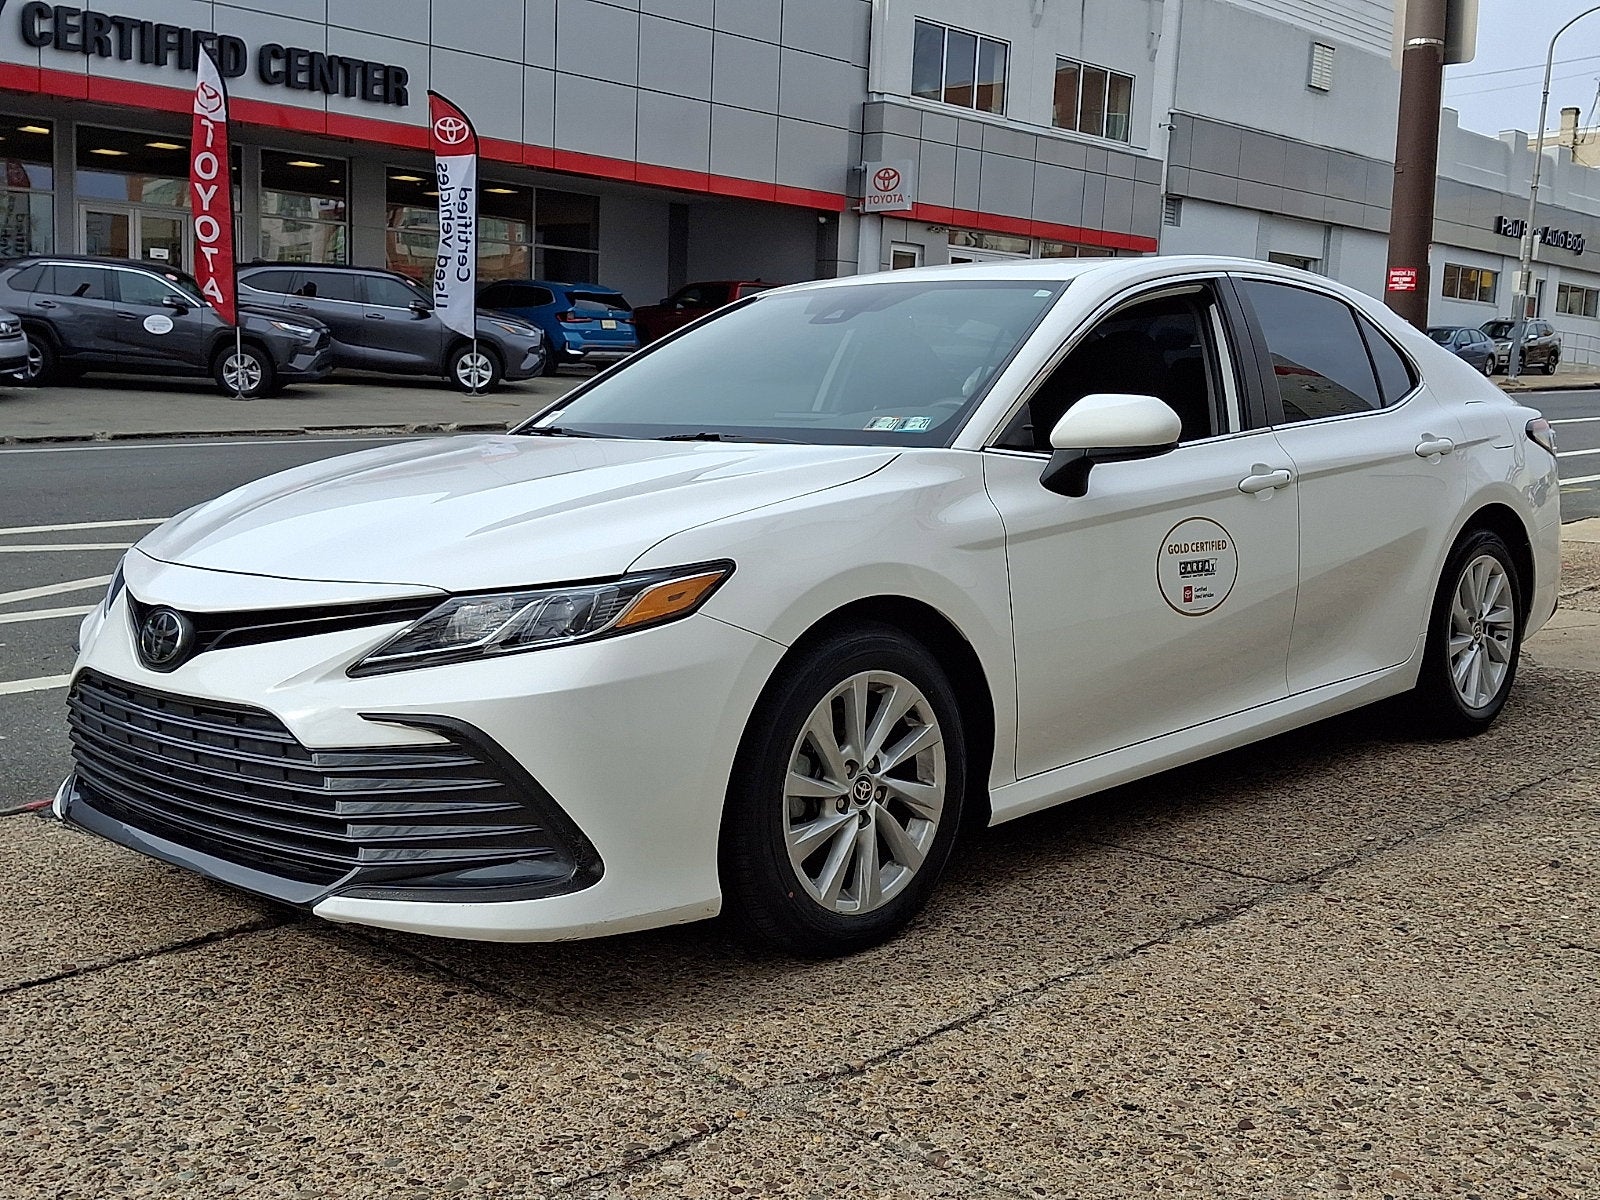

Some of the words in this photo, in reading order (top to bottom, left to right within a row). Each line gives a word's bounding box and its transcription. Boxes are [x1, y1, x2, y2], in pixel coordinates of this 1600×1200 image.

[21, 1, 248, 78] CERTIFIED
[259, 43, 409, 106] CENTER
[194, 118, 223, 304] TOYOTA
[868, 194, 904, 205] TOYOTA
[1498, 215, 1521, 238] Paul
[1544, 228, 1566, 248] Auto
[1566, 230, 1586, 256] Body
[1168, 543, 1189, 555] GOLD
[1190, 539, 1227, 553] CERTIFIED
[1179, 559, 1217, 575] CARFAX
